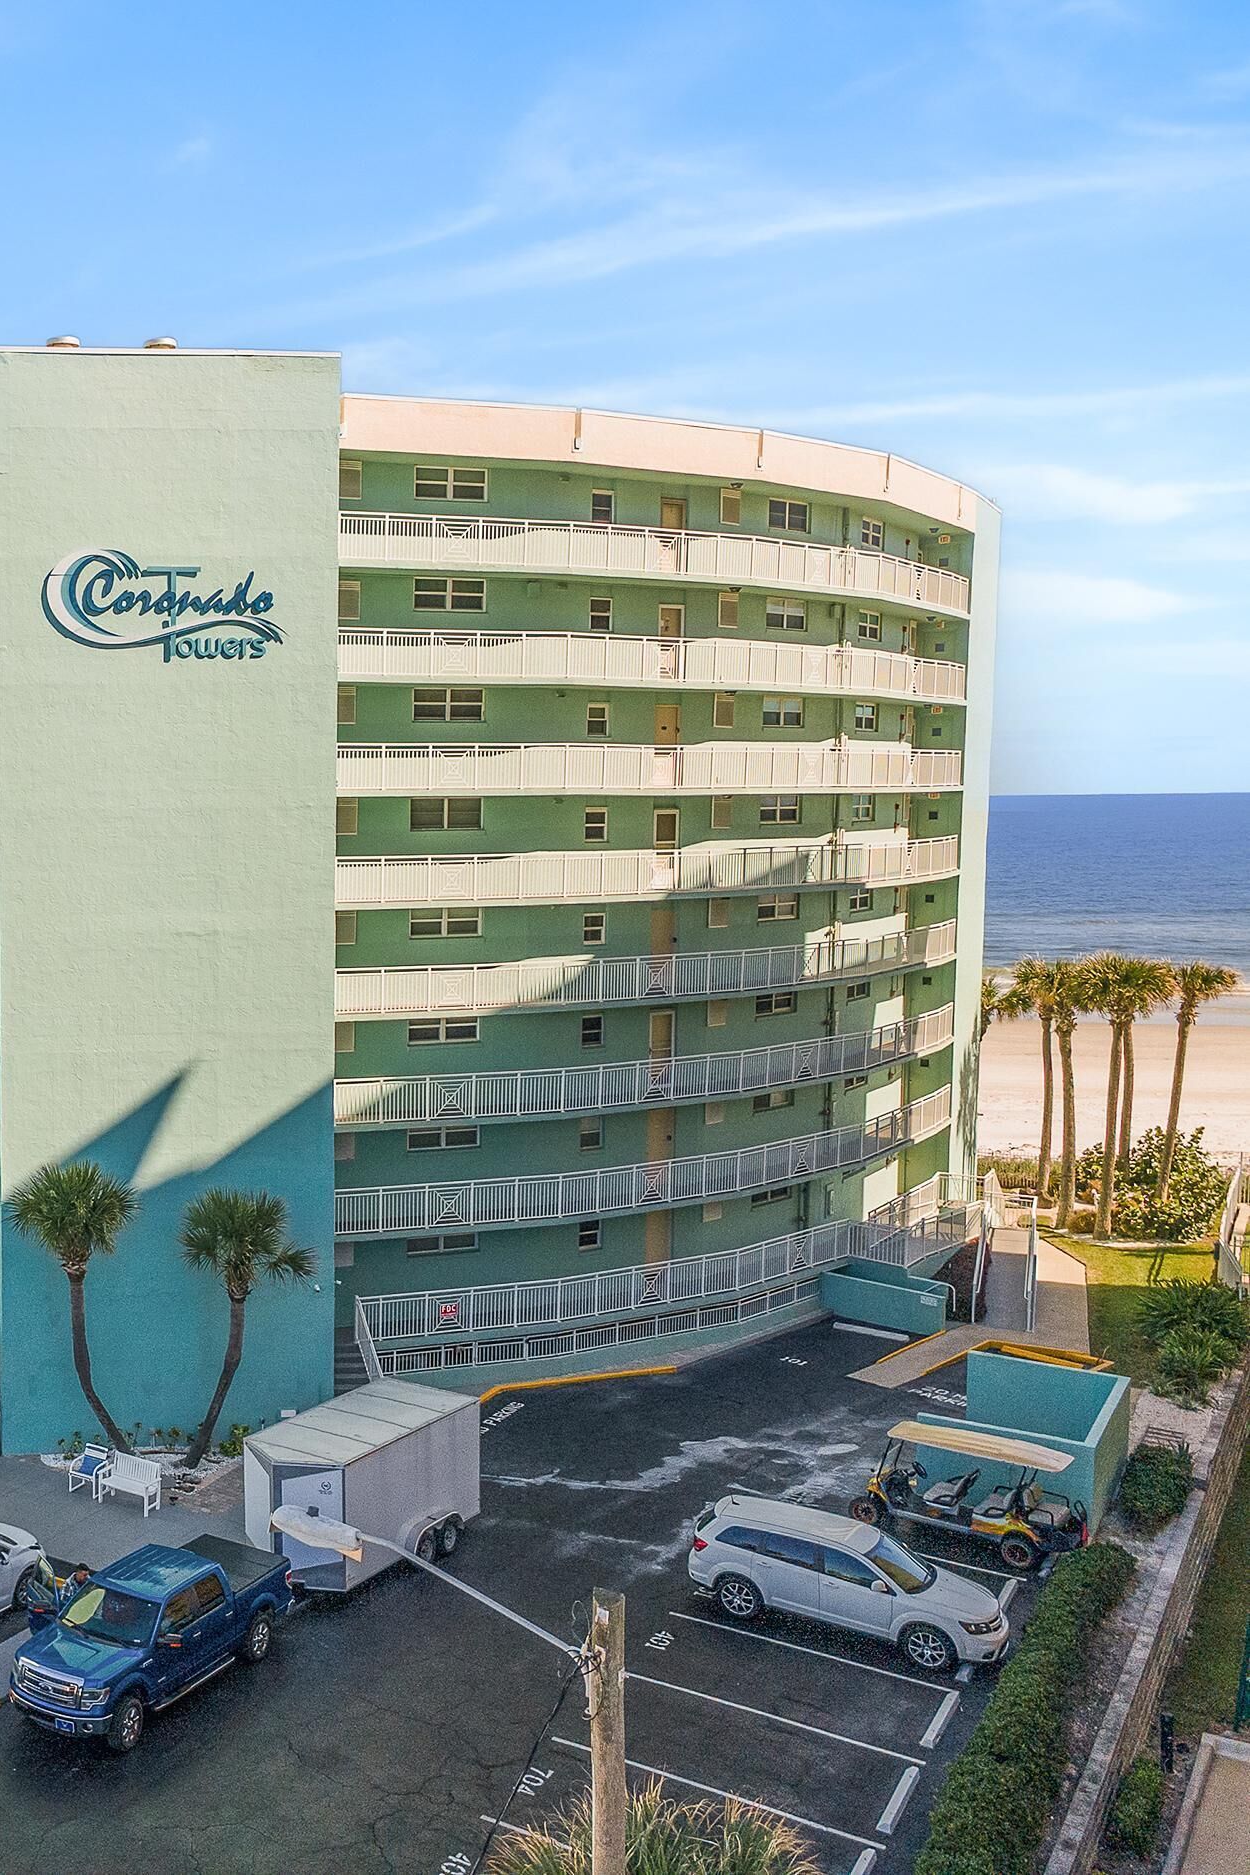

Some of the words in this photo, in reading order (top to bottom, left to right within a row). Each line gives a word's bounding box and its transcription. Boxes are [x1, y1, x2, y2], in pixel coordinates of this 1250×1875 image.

[81, 567, 274, 617] Coronado
[441, 1304, 456, 1313] FDC
[780, 1356, 807, 1366] 101
[644, 1630, 675, 1651] 401
[513, 1766, 555, 1796] 704
[438, 1852, 472, 1875] 40
